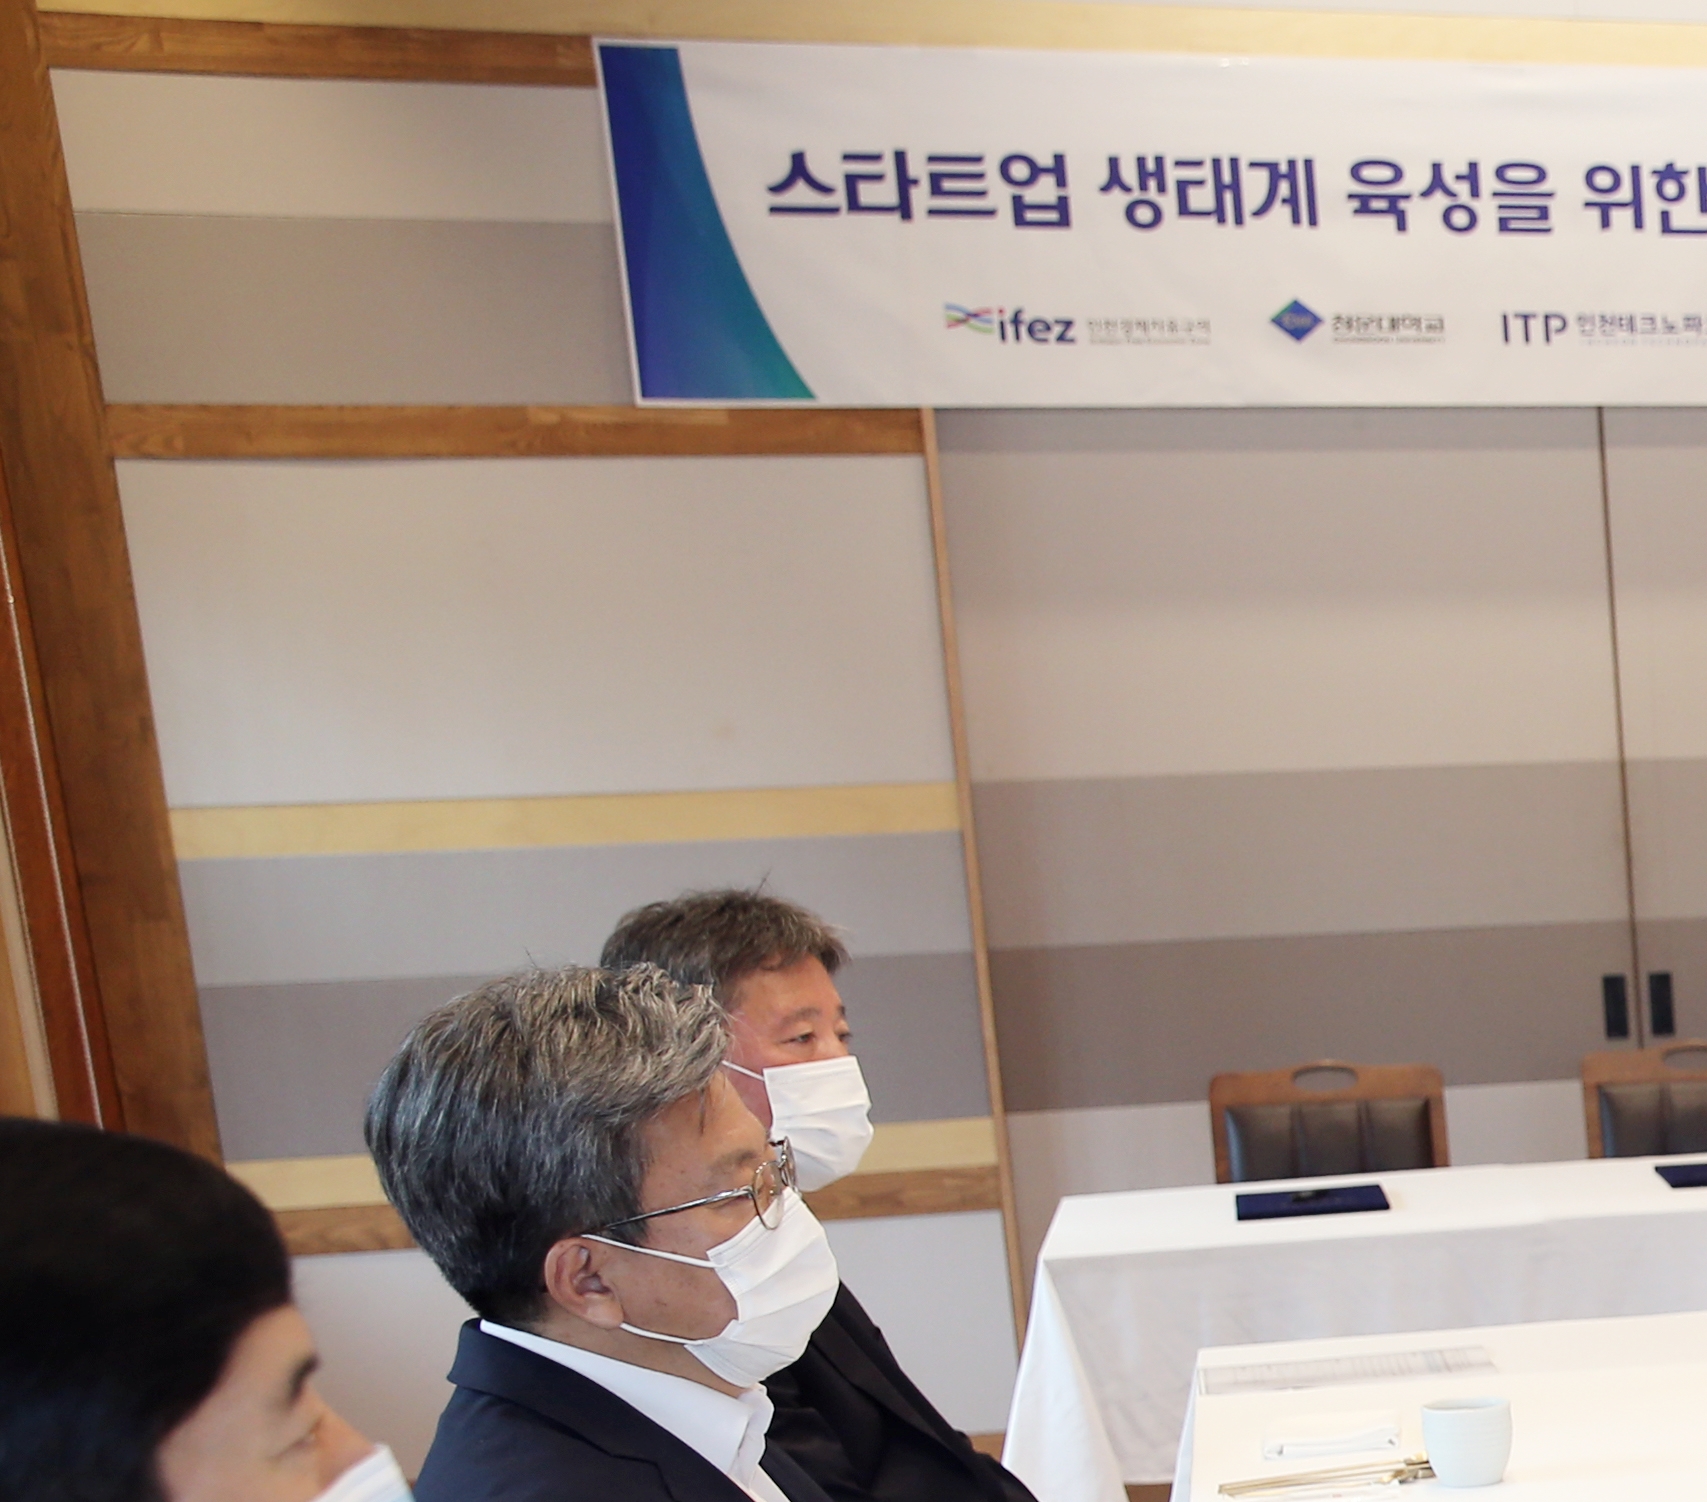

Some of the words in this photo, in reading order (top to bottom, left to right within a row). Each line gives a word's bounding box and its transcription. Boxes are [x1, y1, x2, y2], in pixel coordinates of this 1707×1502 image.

[764, 147, 1073, 230] 스타트업
[1098, 154, 1319, 232] 생태계
[1346, 159, 1556, 235] 육성을
[998, 307, 1076, 345] ifez
[1501, 312, 1568, 345] ITP
